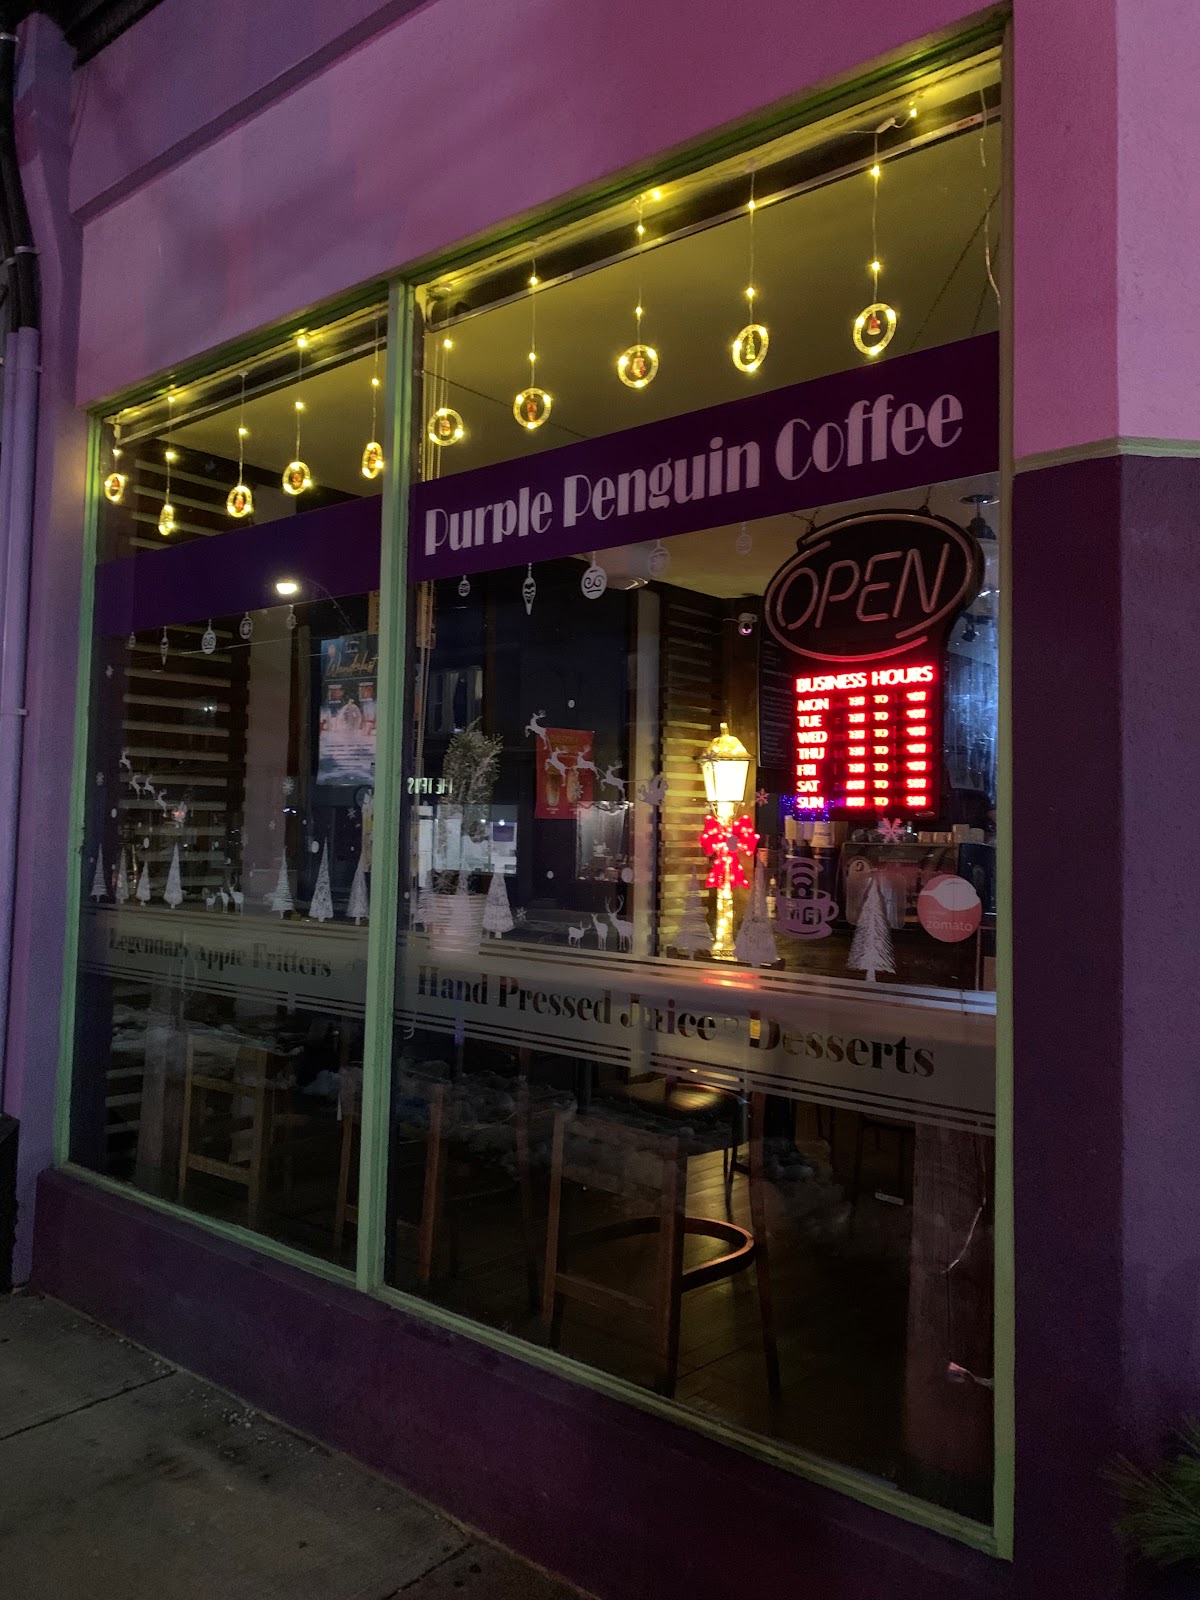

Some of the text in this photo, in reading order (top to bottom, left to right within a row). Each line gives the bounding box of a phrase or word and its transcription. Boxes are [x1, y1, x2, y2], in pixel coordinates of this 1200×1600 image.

[423, 393, 965, 557] Purple Penguin Coffee
[776, 548, 951, 631] OPEN
[795, 665, 934, 693] BUSINESS HOURS
[796, 697, 830, 712] MON
[872, 694, 889, 704] TO
[796, 714, 822, 728] TUE
[872, 711, 889, 721] TO
[796, 730, 828, 744] WED
[873, 728, 889, 738] TO
[796, 747, 825, 760] THU
[872, 745, 889, 755] TO
[796, 763, 817, 777] FRI
[872, 762, 889, 772] TO
[796, 779, 820, 793] SAT
[873, 779, 889, 790] TO
[796, 796, 825, 809] SUN
[873, 796, 889, 807] TO
[926, 919, 974, 932] zomato
[198, 946, 247, 971] Apple
[253, 942, 332, 978] Fritters
[417, 965, 936, 1078] Hand Pressed Juice Desserts
